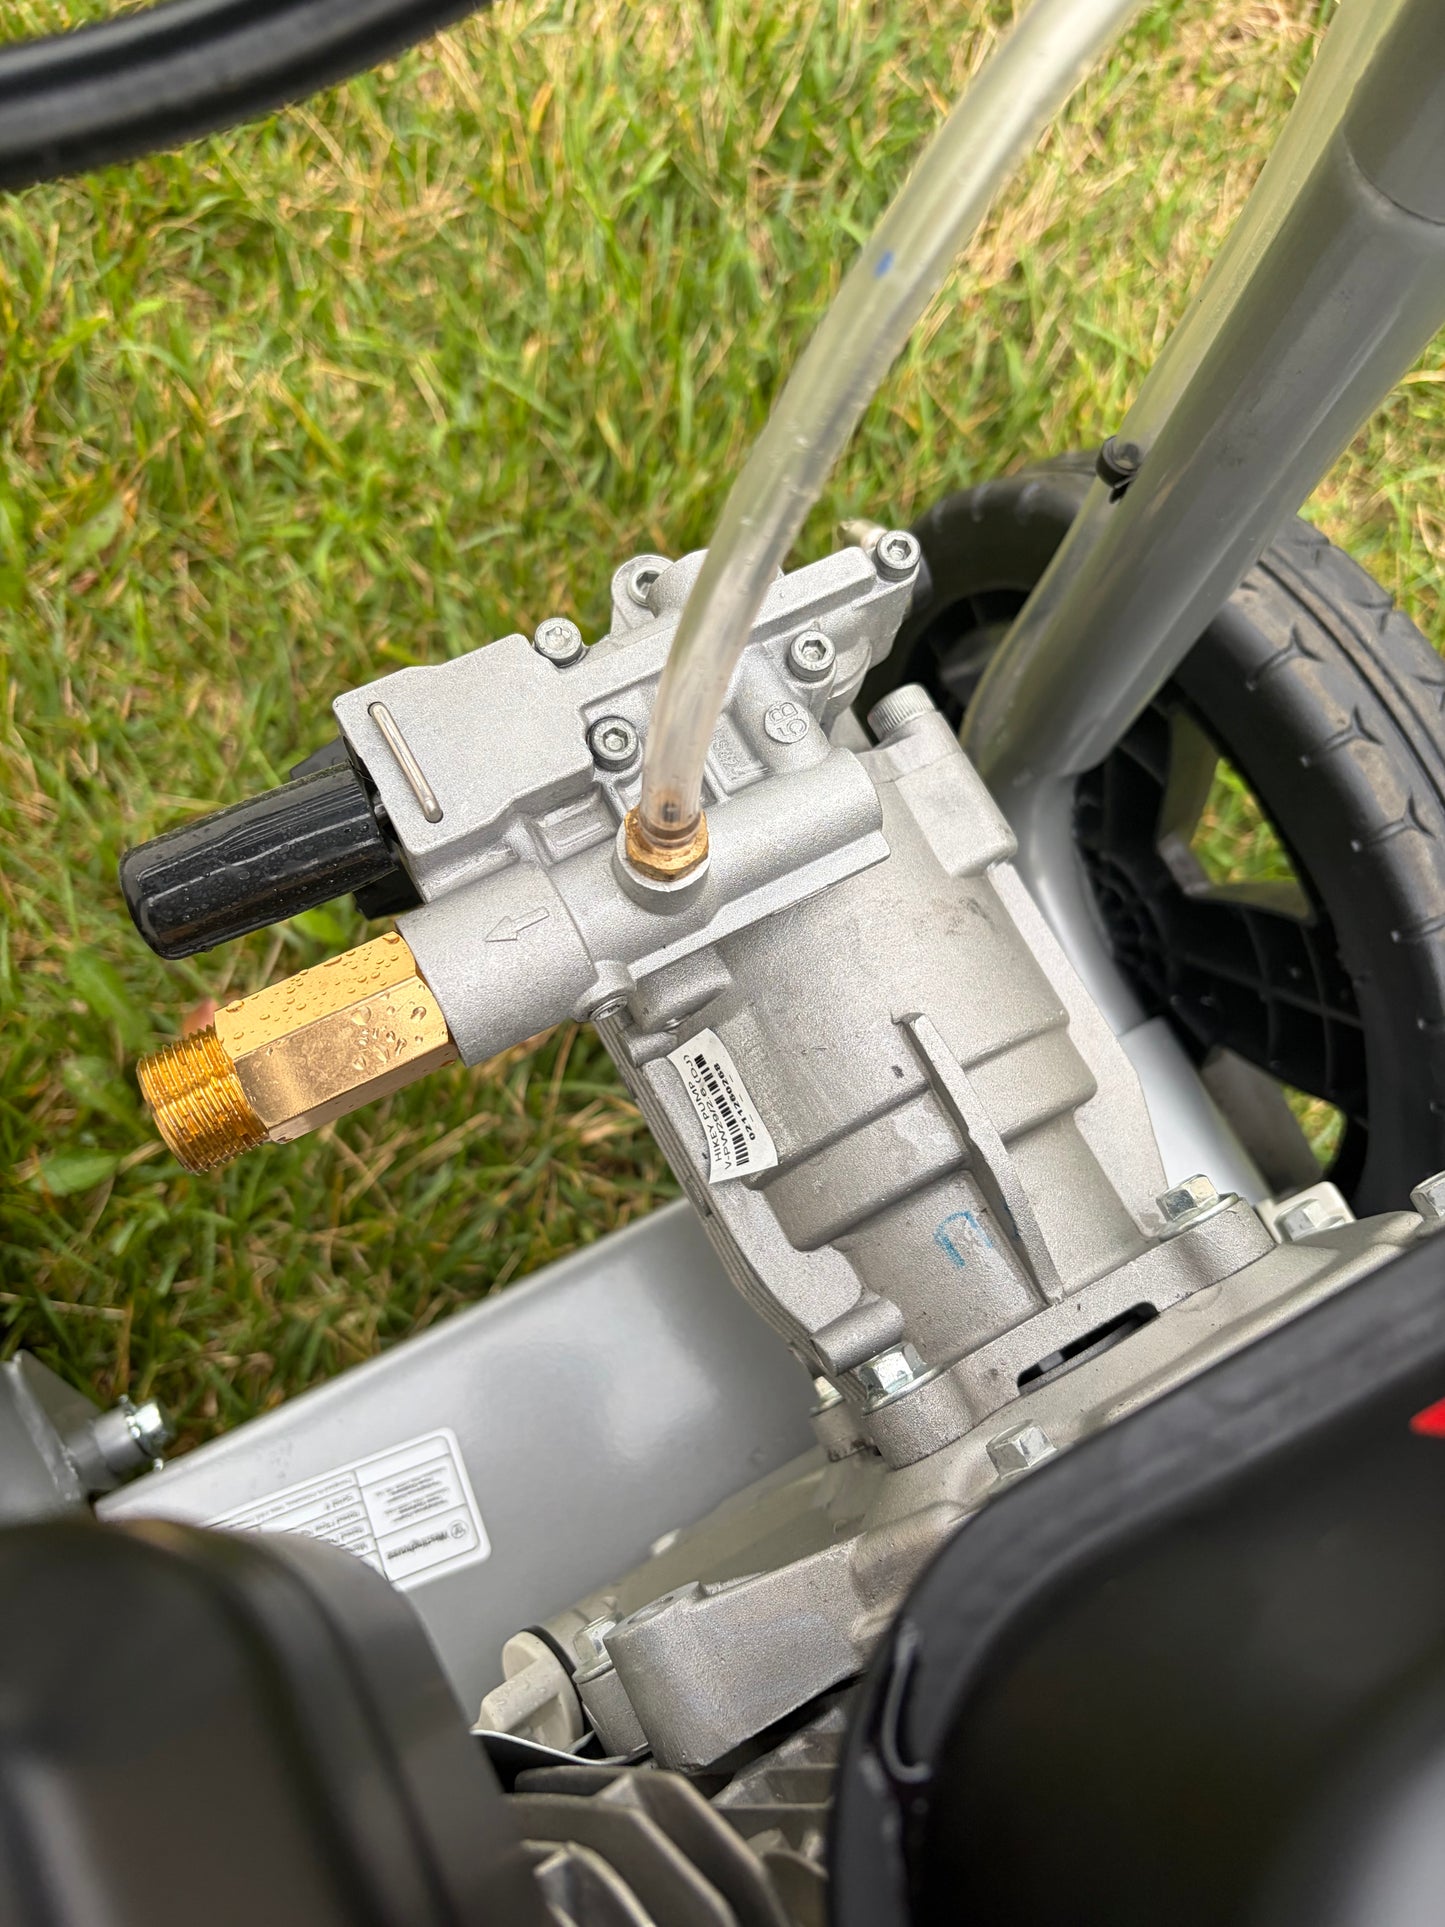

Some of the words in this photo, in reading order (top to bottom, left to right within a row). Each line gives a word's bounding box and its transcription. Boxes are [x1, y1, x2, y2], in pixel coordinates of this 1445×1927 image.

[683, 1054, 701, 1084] (DJ)
[688, 1081, 709, 1120] PUMP
[701, 1087, 732, 1170] V-PW29/2.6
[707, 1124, 722, 1162] HIKEY
